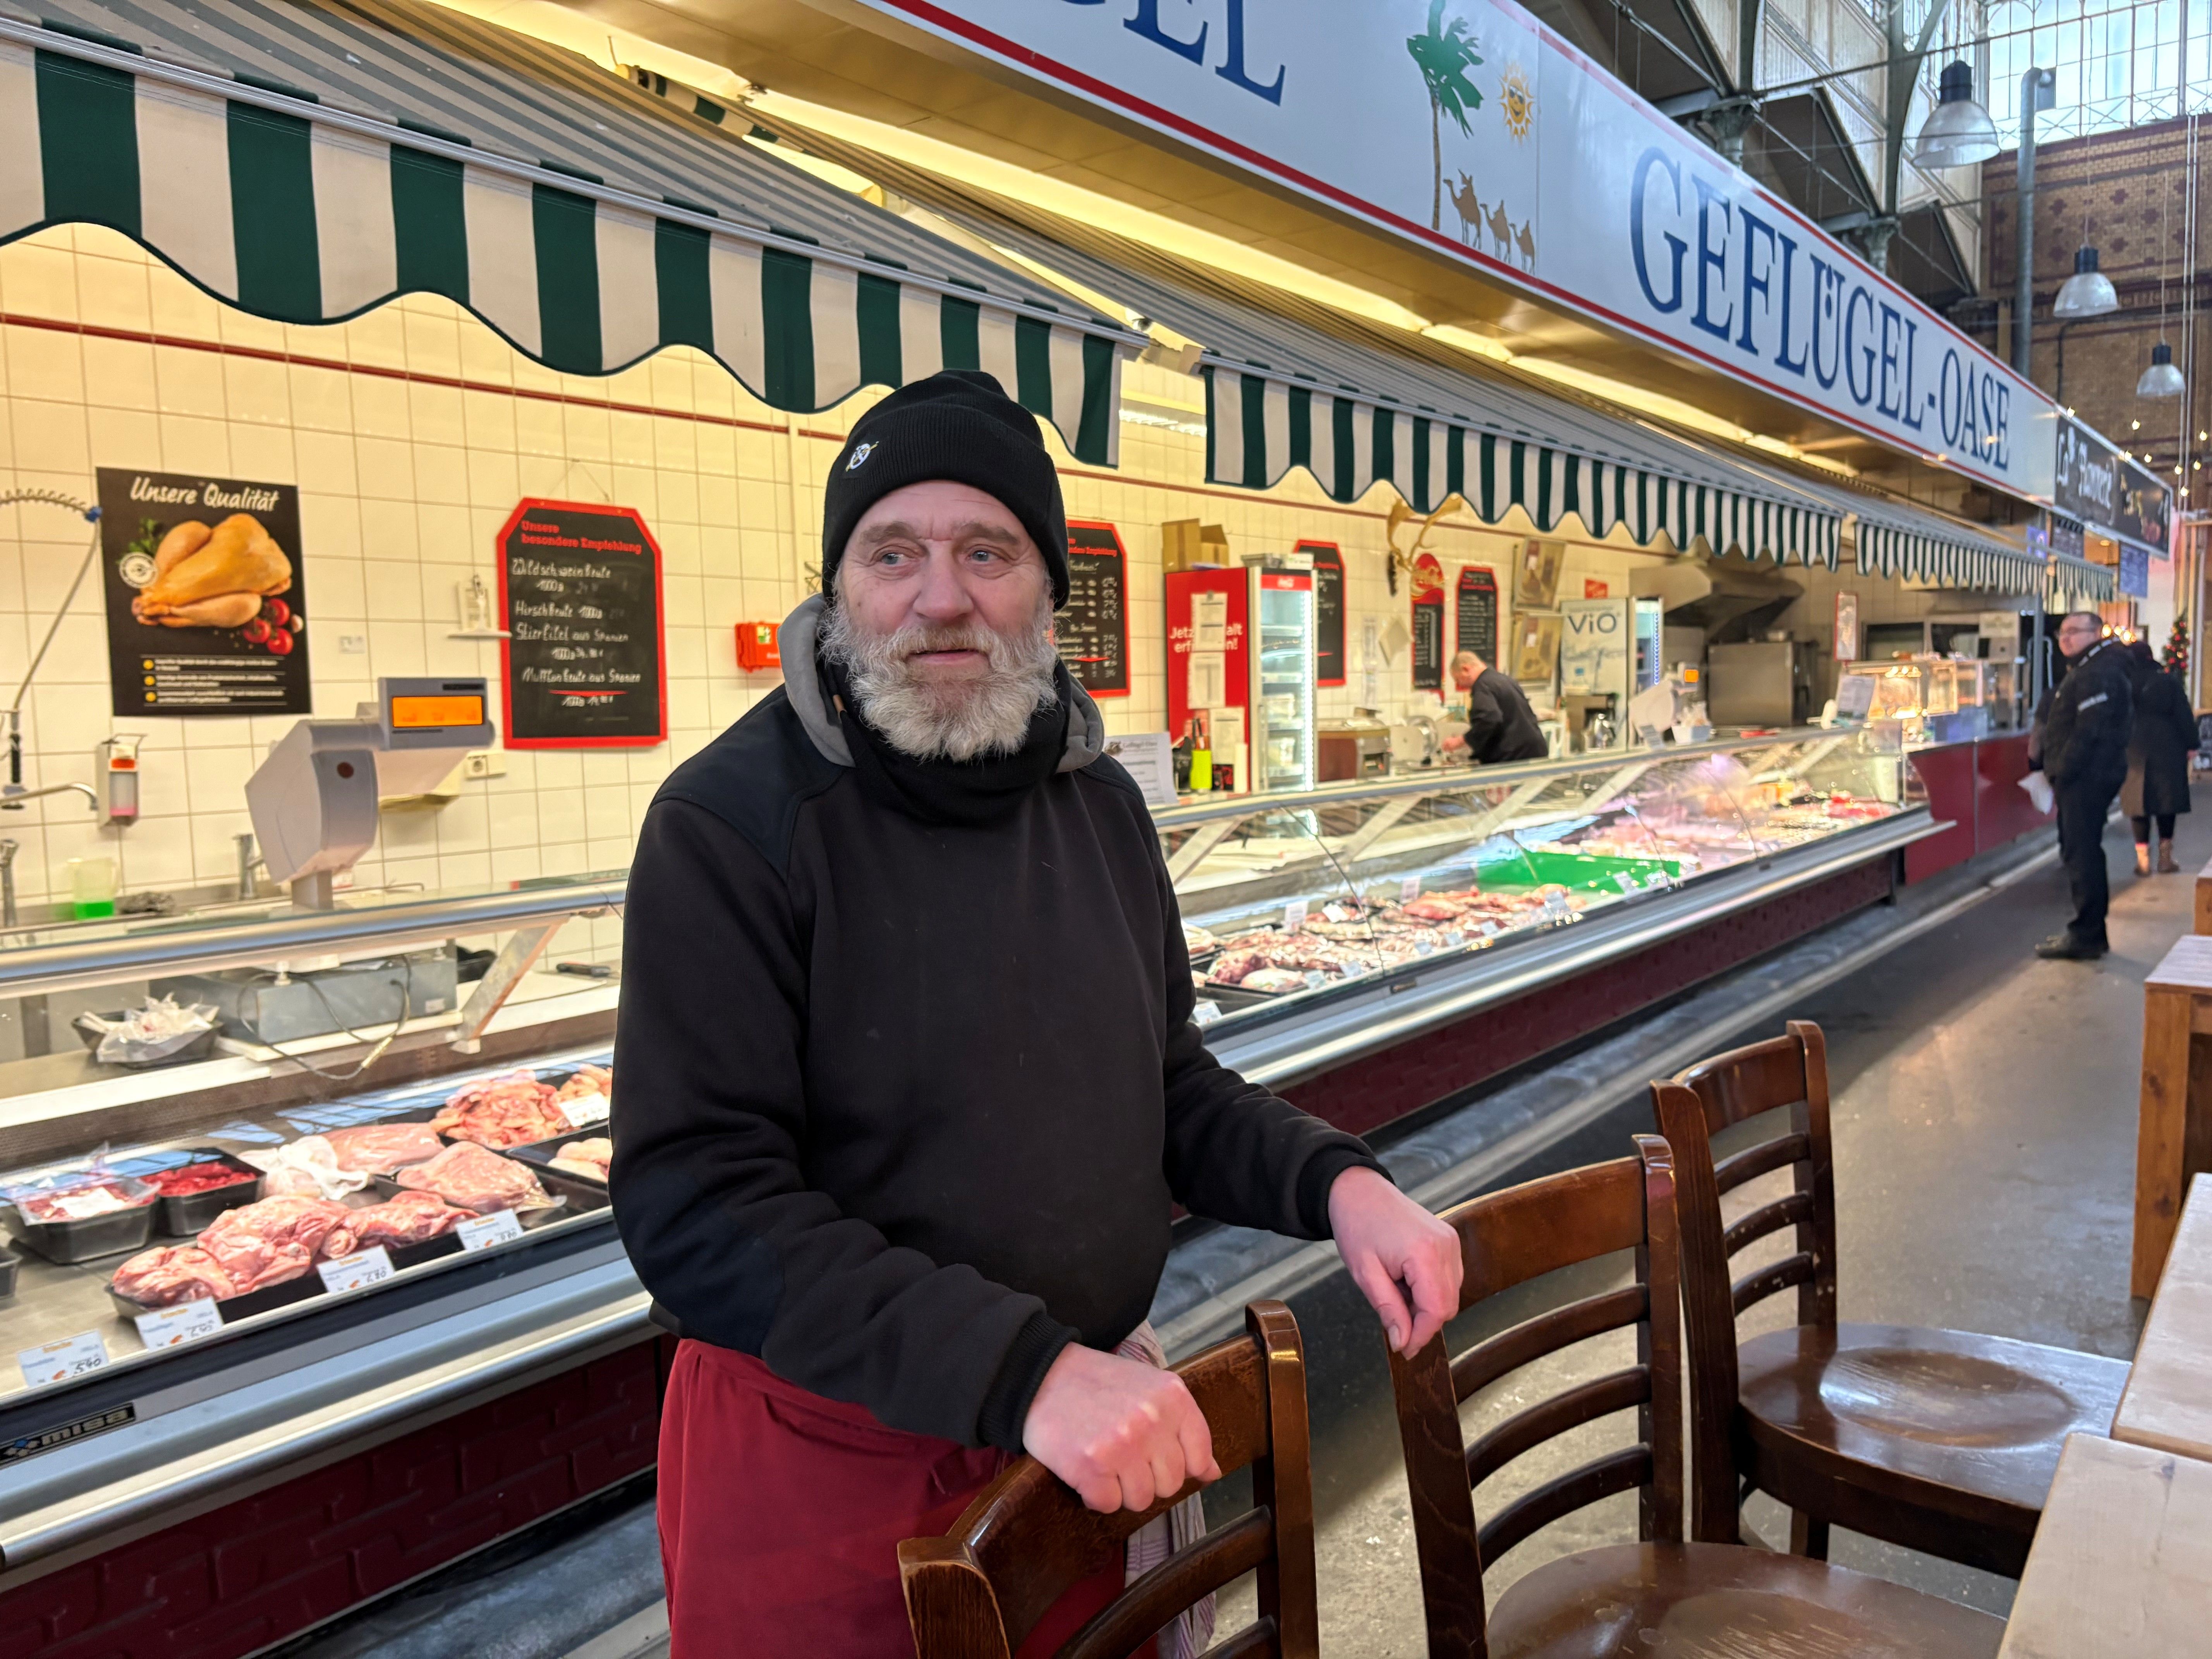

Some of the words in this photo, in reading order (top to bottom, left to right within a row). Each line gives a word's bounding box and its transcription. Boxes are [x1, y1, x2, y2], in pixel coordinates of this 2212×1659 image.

[1630, 147, 2010, 471] GEFLÜGEL-OASE
[130, 476, 198, 505] Unsere
[203, 483, 280, 512] Qualität
[520, 520, 560, 534] Unsere
[520, 533, 579, 548] besondere
[580, 536, 642, 555] Empfehlung
[1169, 626, 1194, 639] Jetz
[1226, 623, 1242, 636] alt
[1568, 612, 1617, 634] ViO
